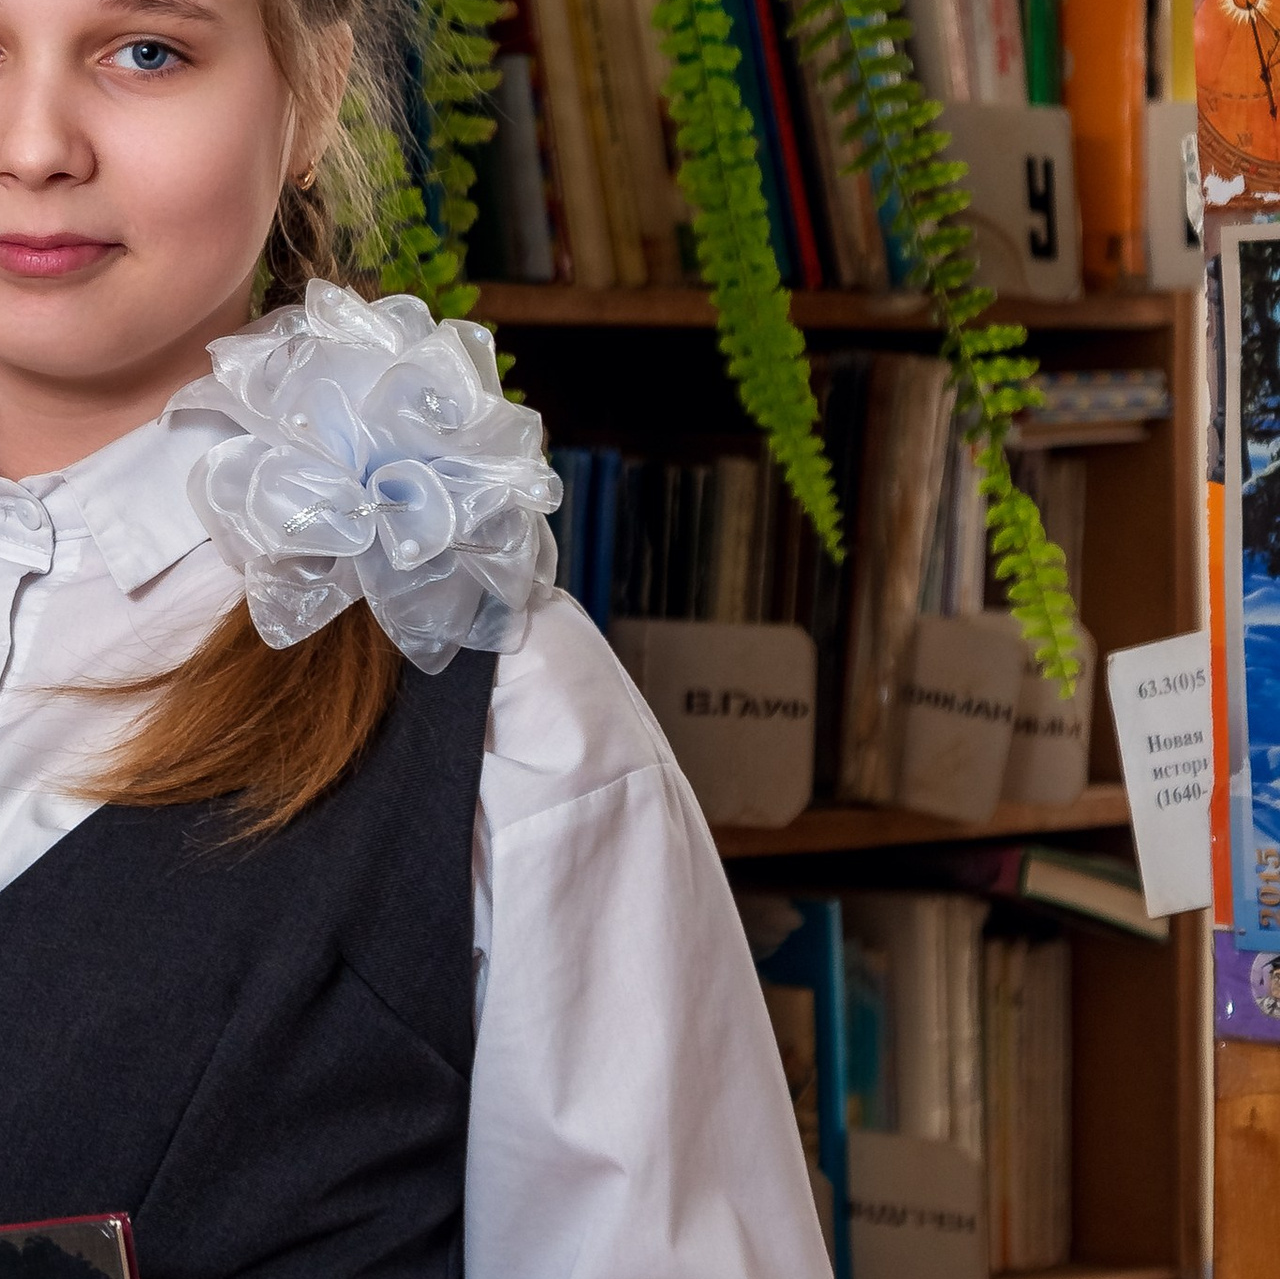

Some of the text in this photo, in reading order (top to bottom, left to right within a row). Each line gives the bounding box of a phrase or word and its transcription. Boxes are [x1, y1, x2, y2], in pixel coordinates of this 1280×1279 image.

[1138, 669, 1206, 699] 63.3(0)5
[1147, 731, 1203, 754] Новая
[1255, 848, 1280, 928] 2015
